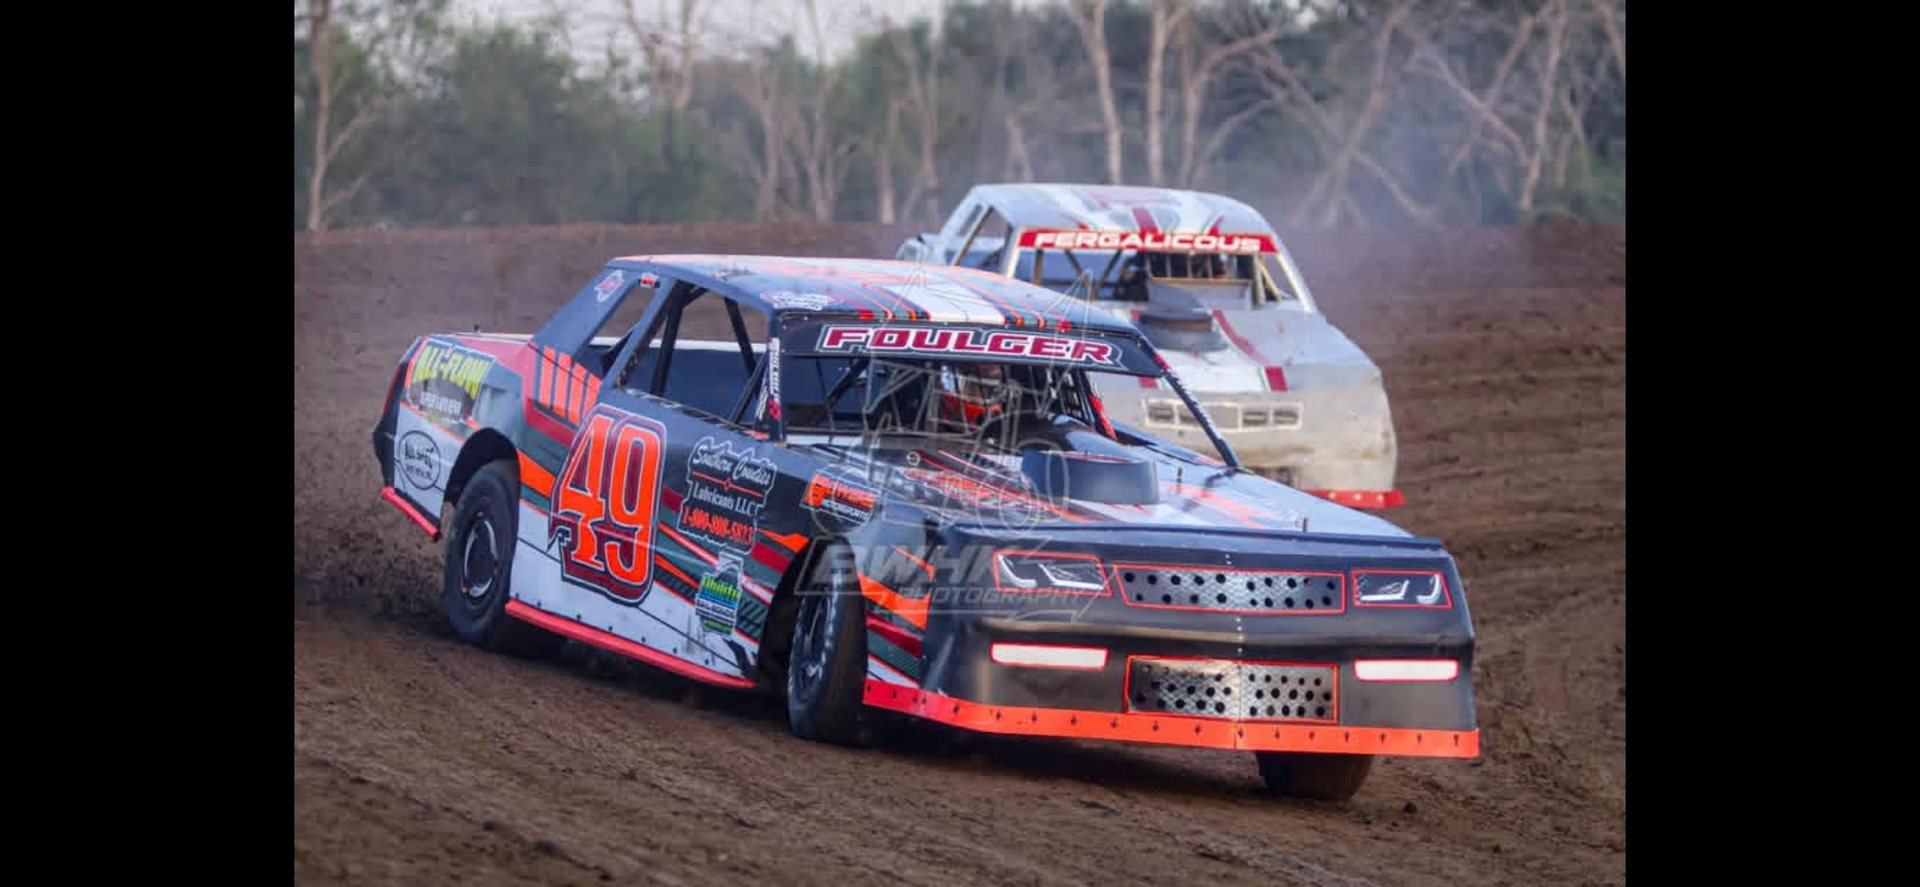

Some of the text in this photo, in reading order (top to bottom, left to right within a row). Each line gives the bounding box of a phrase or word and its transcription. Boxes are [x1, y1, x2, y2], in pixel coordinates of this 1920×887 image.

[1034, 231, 1262, 252] FERGALICOUS
[824, 326, 1114, 366] FOULGER
[555, 408, 665, 603] 49
[735, 497, 757, 518] LLC
